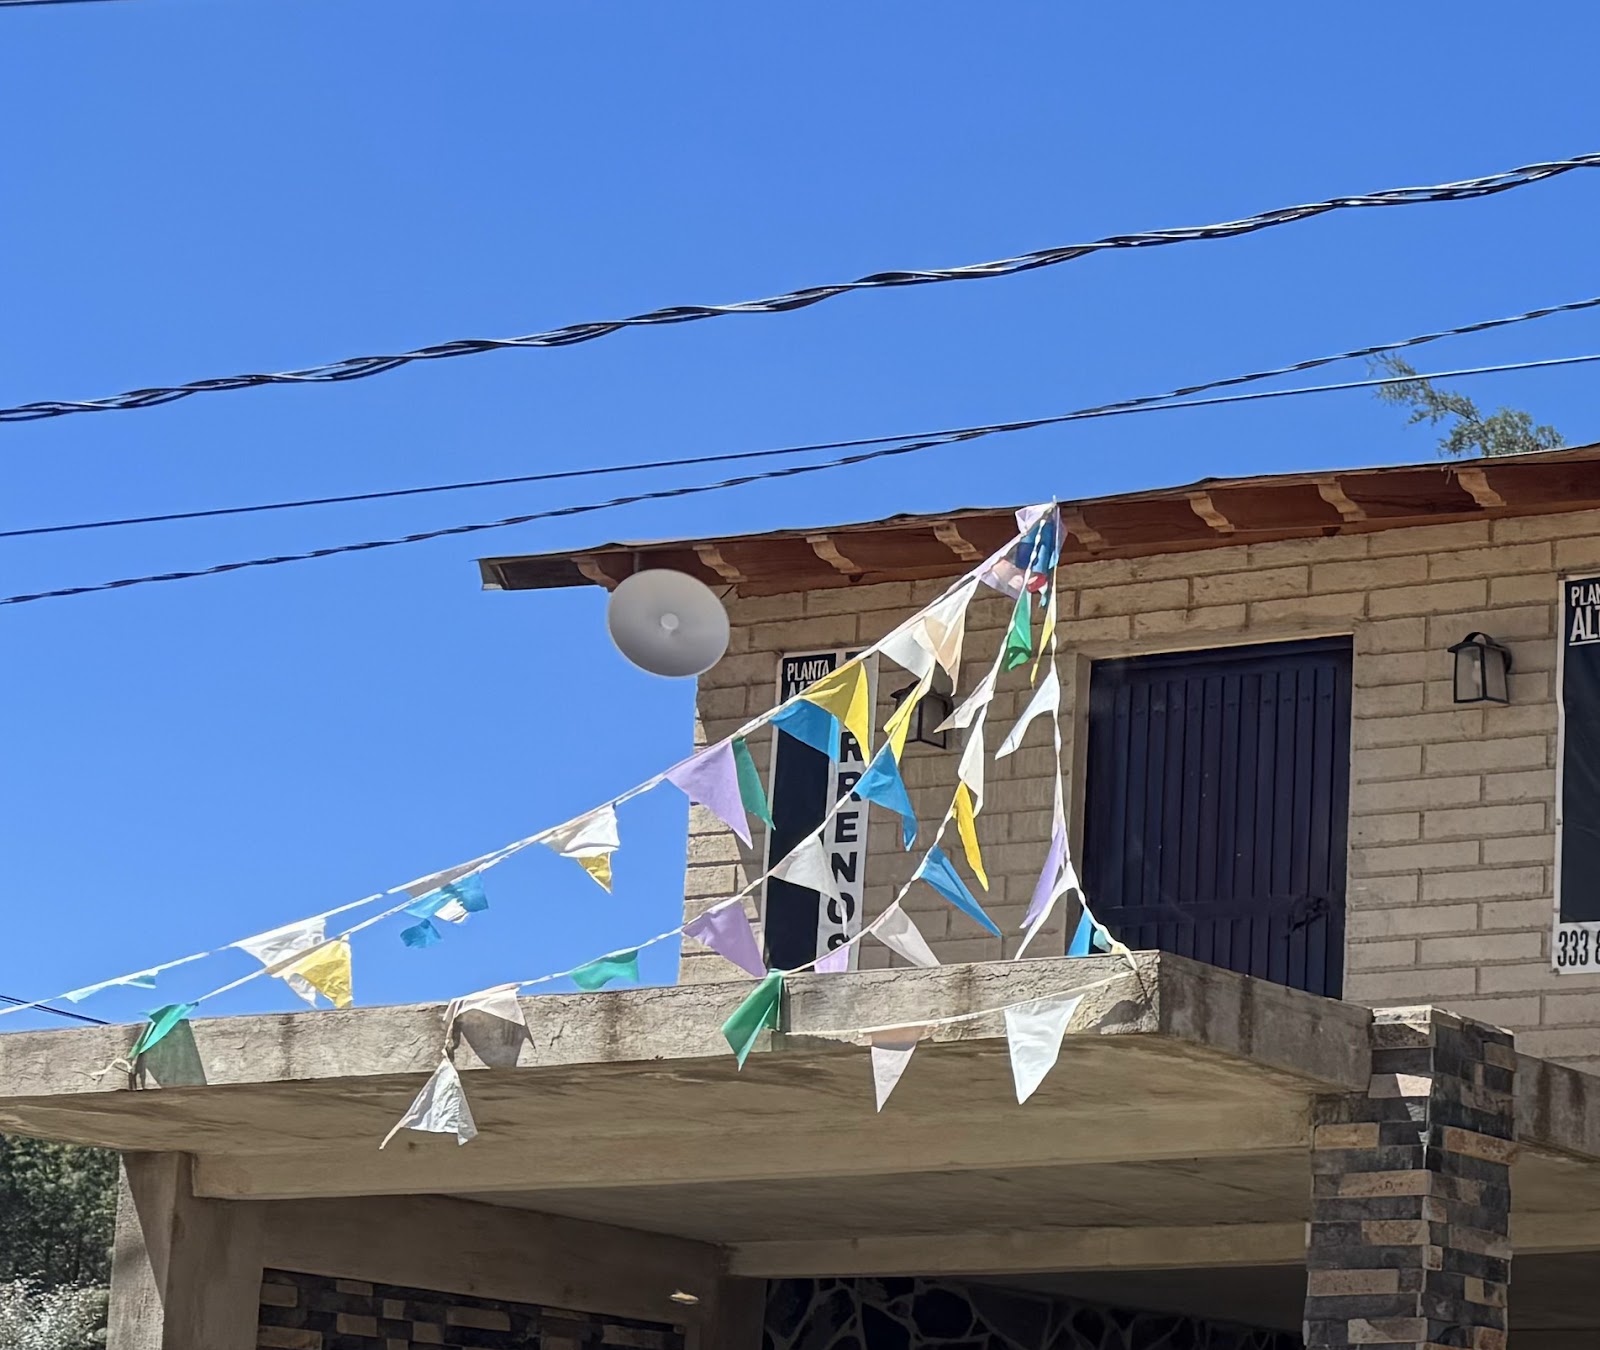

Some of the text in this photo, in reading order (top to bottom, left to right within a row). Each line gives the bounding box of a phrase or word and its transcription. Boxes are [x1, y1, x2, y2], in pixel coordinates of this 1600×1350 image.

[787, 659, 830, 682] PLANTA
[826, 652, 873, 952] RRENO
[1557, 931, 1589, 967] 333
